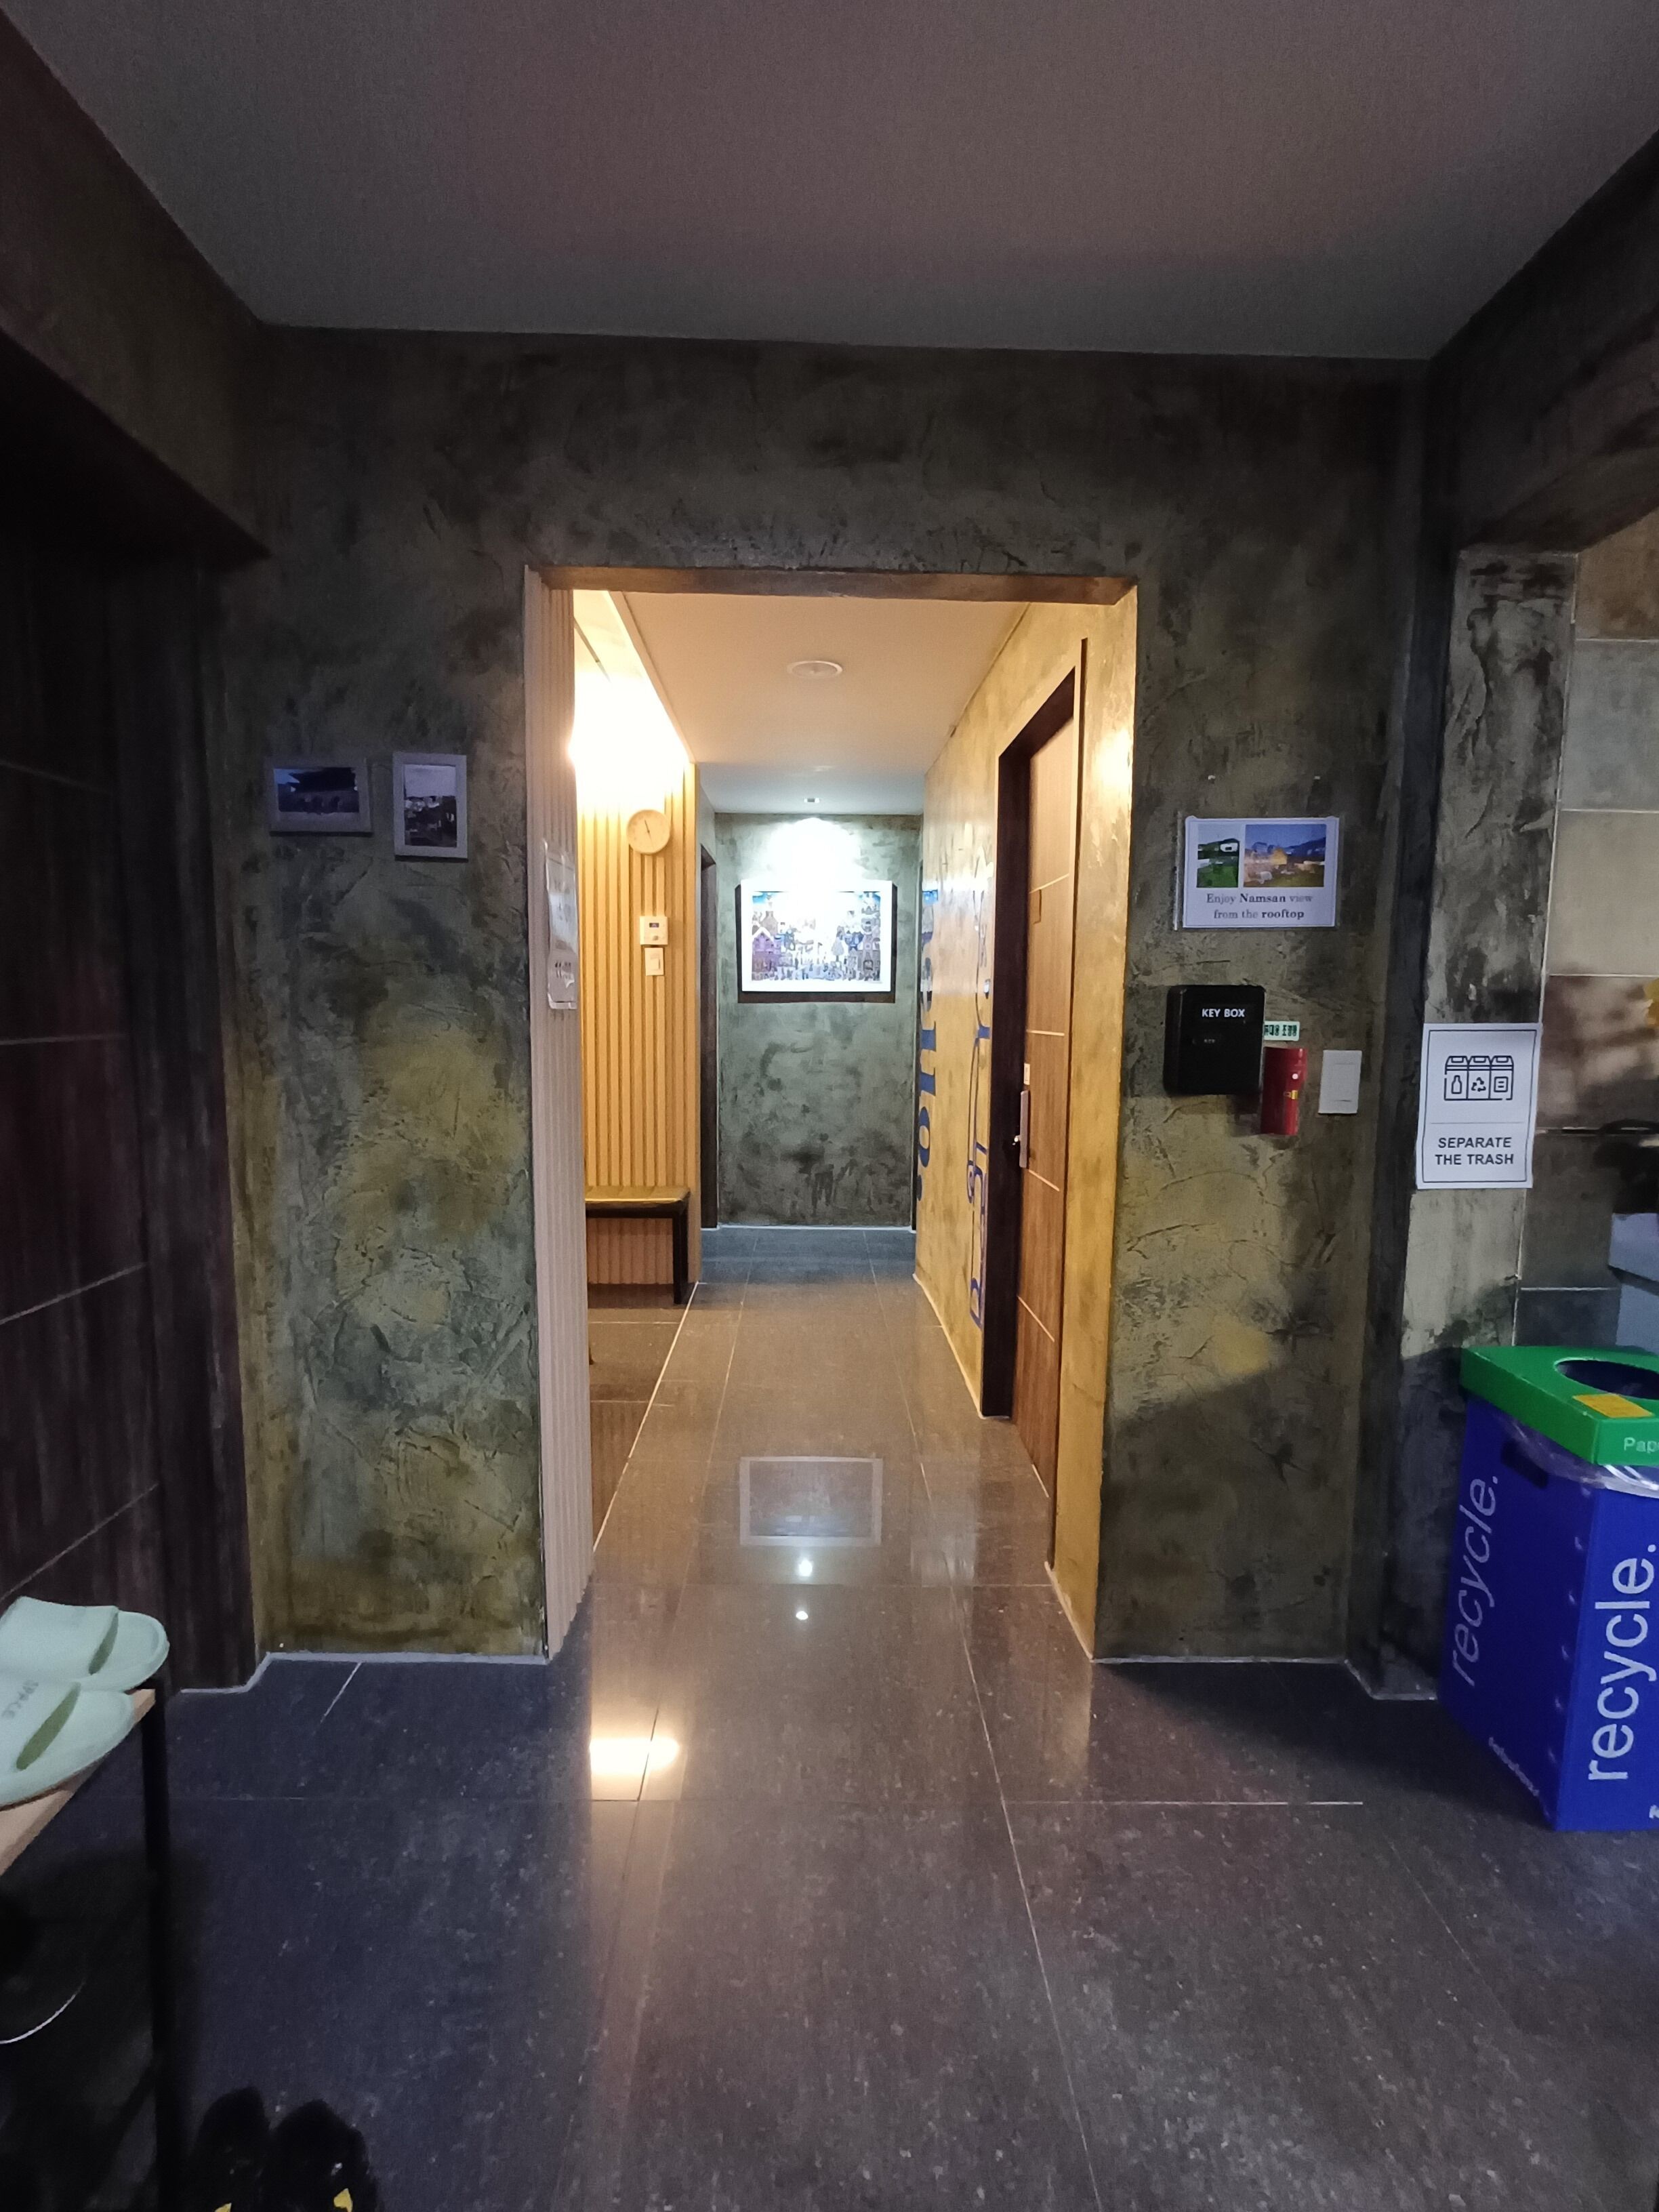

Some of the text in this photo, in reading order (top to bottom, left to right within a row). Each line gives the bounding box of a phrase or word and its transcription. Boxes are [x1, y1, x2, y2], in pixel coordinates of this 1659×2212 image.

[1206, 893, 1313, 905] Enjoy Namsan view
[1214, 909, 1305, 920] from the rooftop
[1202, 1008, 1246, 1018] KEY BOX
[1437, 1137, 1513, 1149] SEPARATE
[1435, 1153, 1515, 1166] THE TRASH
[1624, 1437, 1659, 1454] Pap
[1452, 1475, 1498, 1687] recycle.
[1588, 1544, 1658, 1780] recycle.
